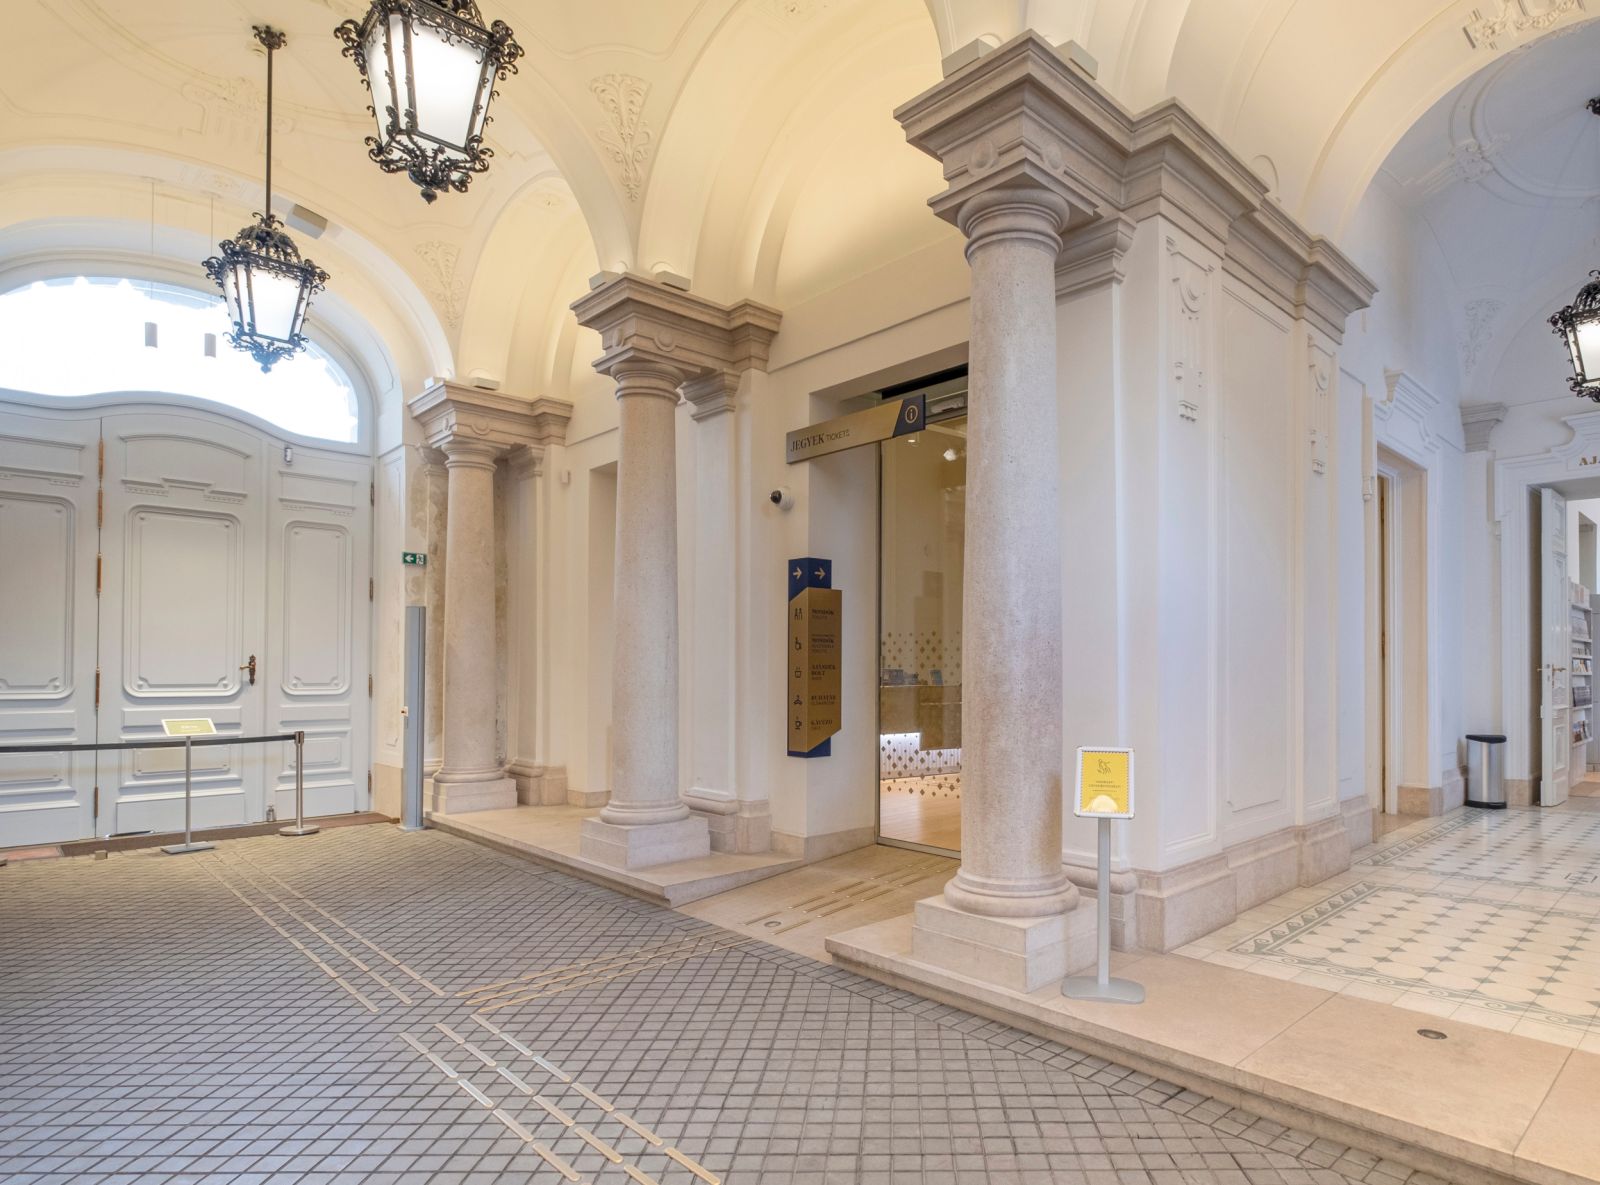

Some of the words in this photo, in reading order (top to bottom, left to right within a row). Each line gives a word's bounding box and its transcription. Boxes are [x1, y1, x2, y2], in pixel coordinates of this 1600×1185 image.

[790, 433, 825, 452] JEGYEK
[826, 428, 850, 440] TICKETS
[1579, 455, 1600, 466] AJ
